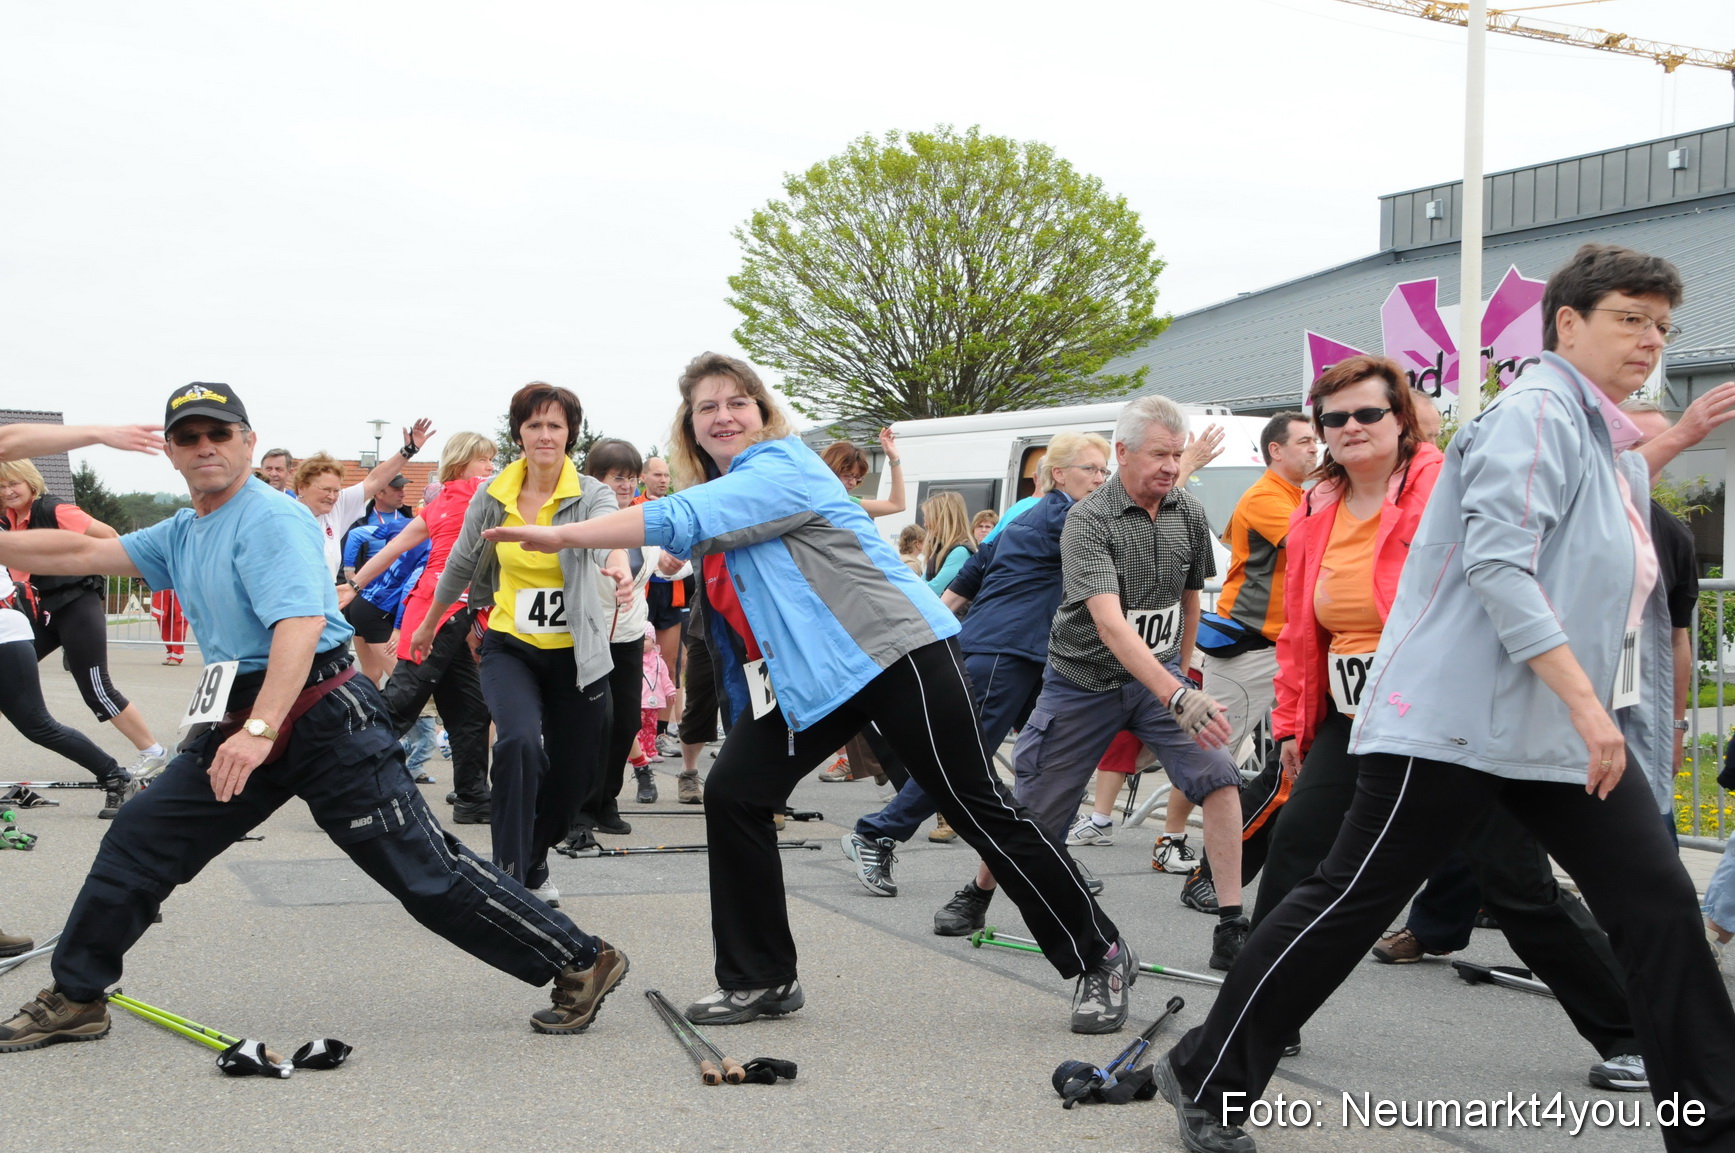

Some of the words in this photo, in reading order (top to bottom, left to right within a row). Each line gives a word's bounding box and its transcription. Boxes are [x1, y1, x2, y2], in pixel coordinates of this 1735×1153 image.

[528, 590, 567, 627] 42
[1135, 610, 1174, 650] 104
[188, 664, 224, 717] 89
